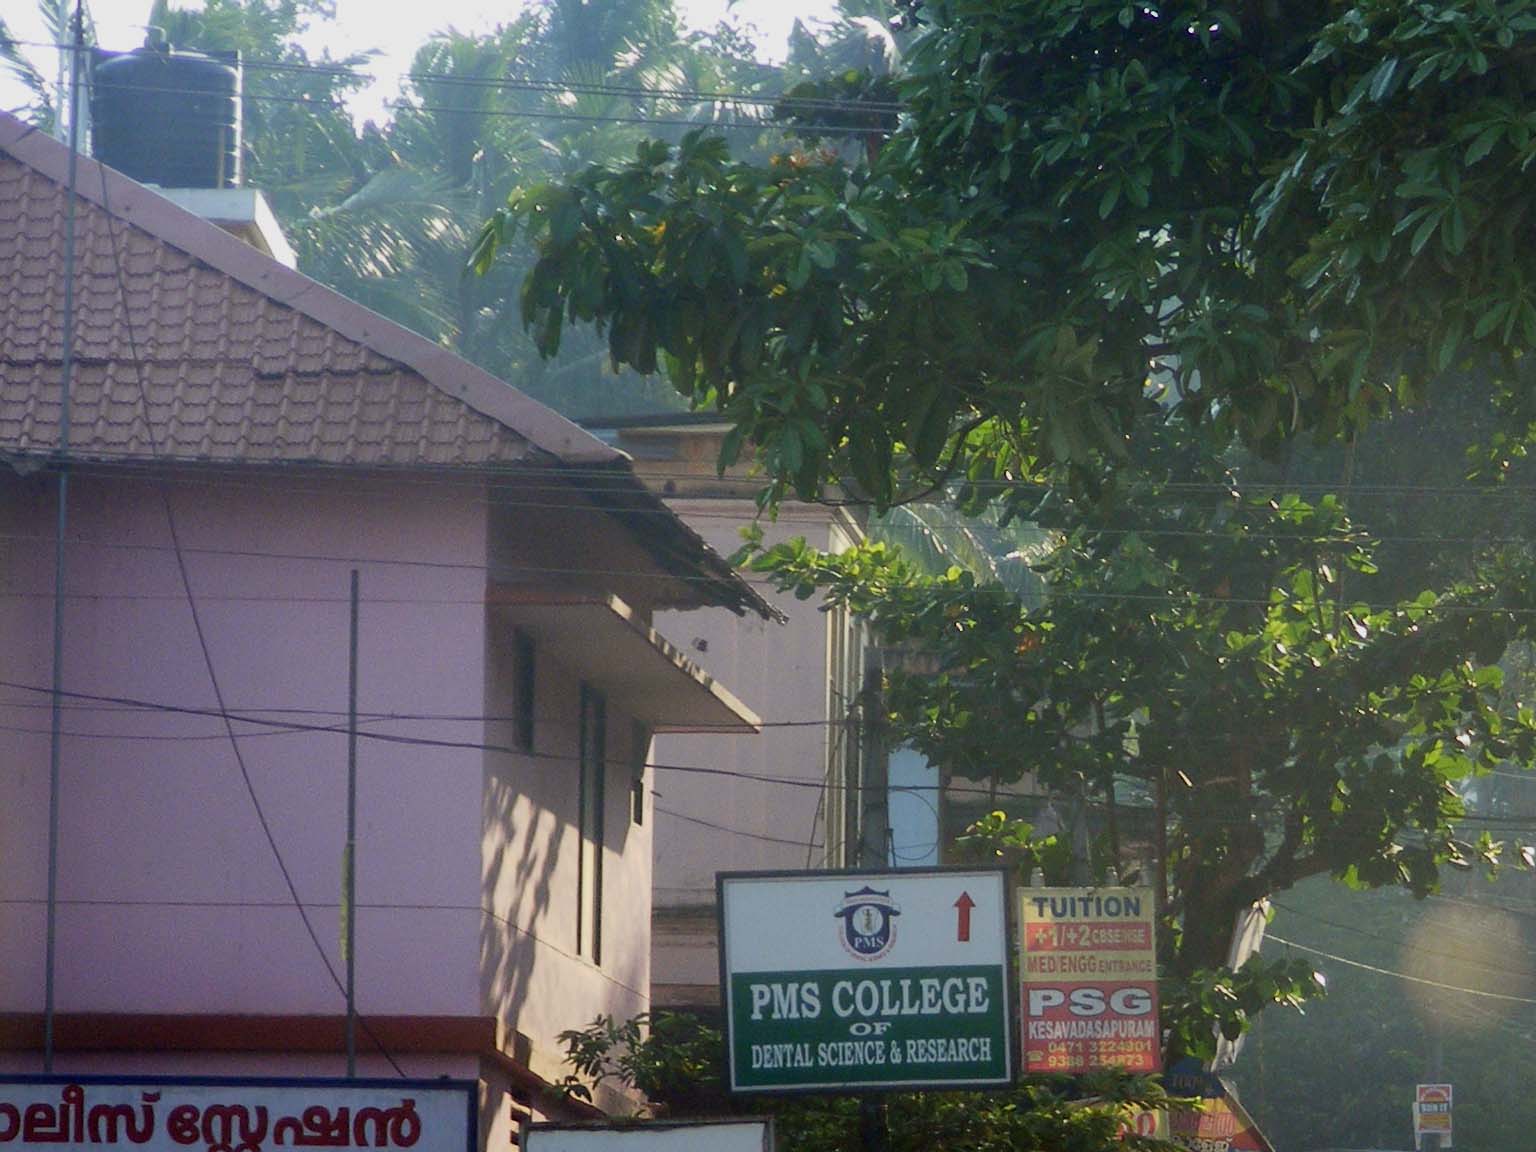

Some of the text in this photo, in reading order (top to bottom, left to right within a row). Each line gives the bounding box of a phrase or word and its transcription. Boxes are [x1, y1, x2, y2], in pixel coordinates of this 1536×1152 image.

[1032, 895, 1141, 918] TUITION
[854, 936, 886, 949] PMS
[750, 976, 991, 1021] PMS COLLEGE
[1028, 987, 1153, 1018] PSG
[849, 1021, 893, 1036] OF
[1028, 1020, 1155, 1040] KESAVADASAPURAM
[751, 1037, 993, 1069] DENTAL SCIENCE & RESEARCH
